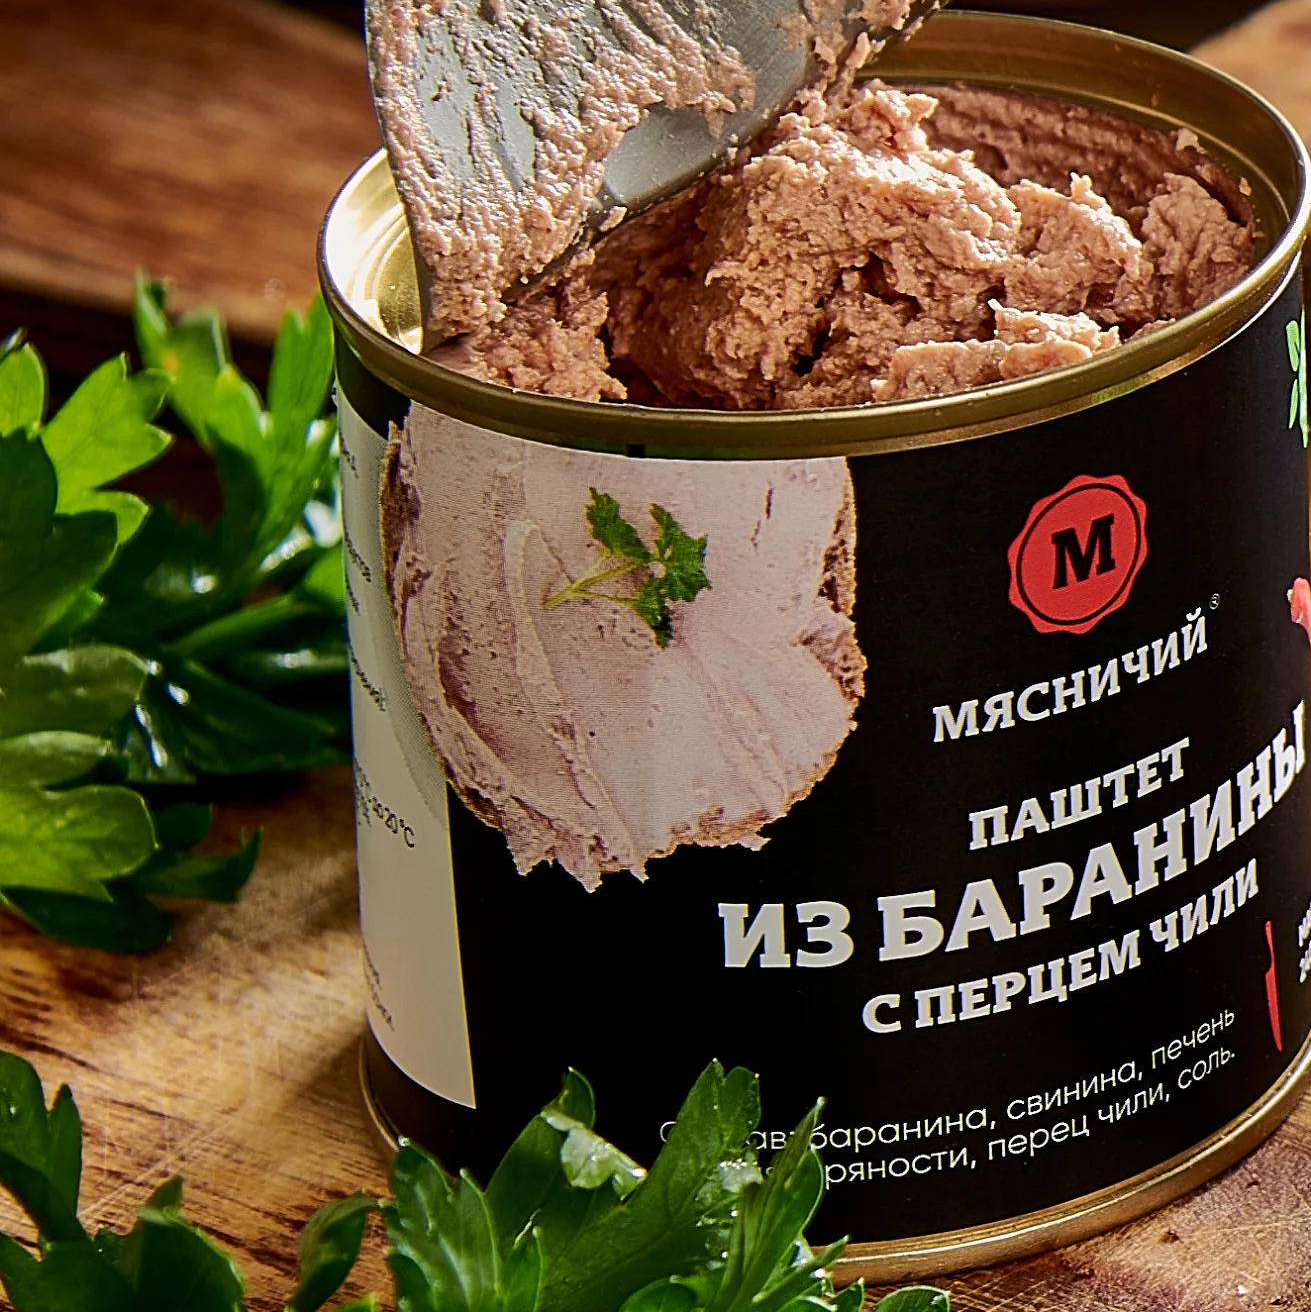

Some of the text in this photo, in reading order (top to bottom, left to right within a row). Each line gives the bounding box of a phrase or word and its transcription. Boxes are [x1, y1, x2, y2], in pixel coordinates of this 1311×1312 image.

[1051, 513, 1116, 589] М
[932, 606, 1208, 743] МЯСНИЧИЙ
[717, 900, 854, 969] ИЗ
[876, 699, 1306, 962] БАРАНИНЫ
[968, 736, 1190, 851] ПАШТЕТ
[862, 993, 902, 1034] С
[914, 929, 1142, 1029] ПЕРЦЕМ
[1149, 857, 1259, 953] ЧИЛИ
[809, 1108, 996, 1154] баранина,
[1006, 1060, 1143, 1120] свинина,
[1151, 1009, 1235, 1069] печень
[824, 1047, 1235, 1190] ряности, перец чили, соль.
